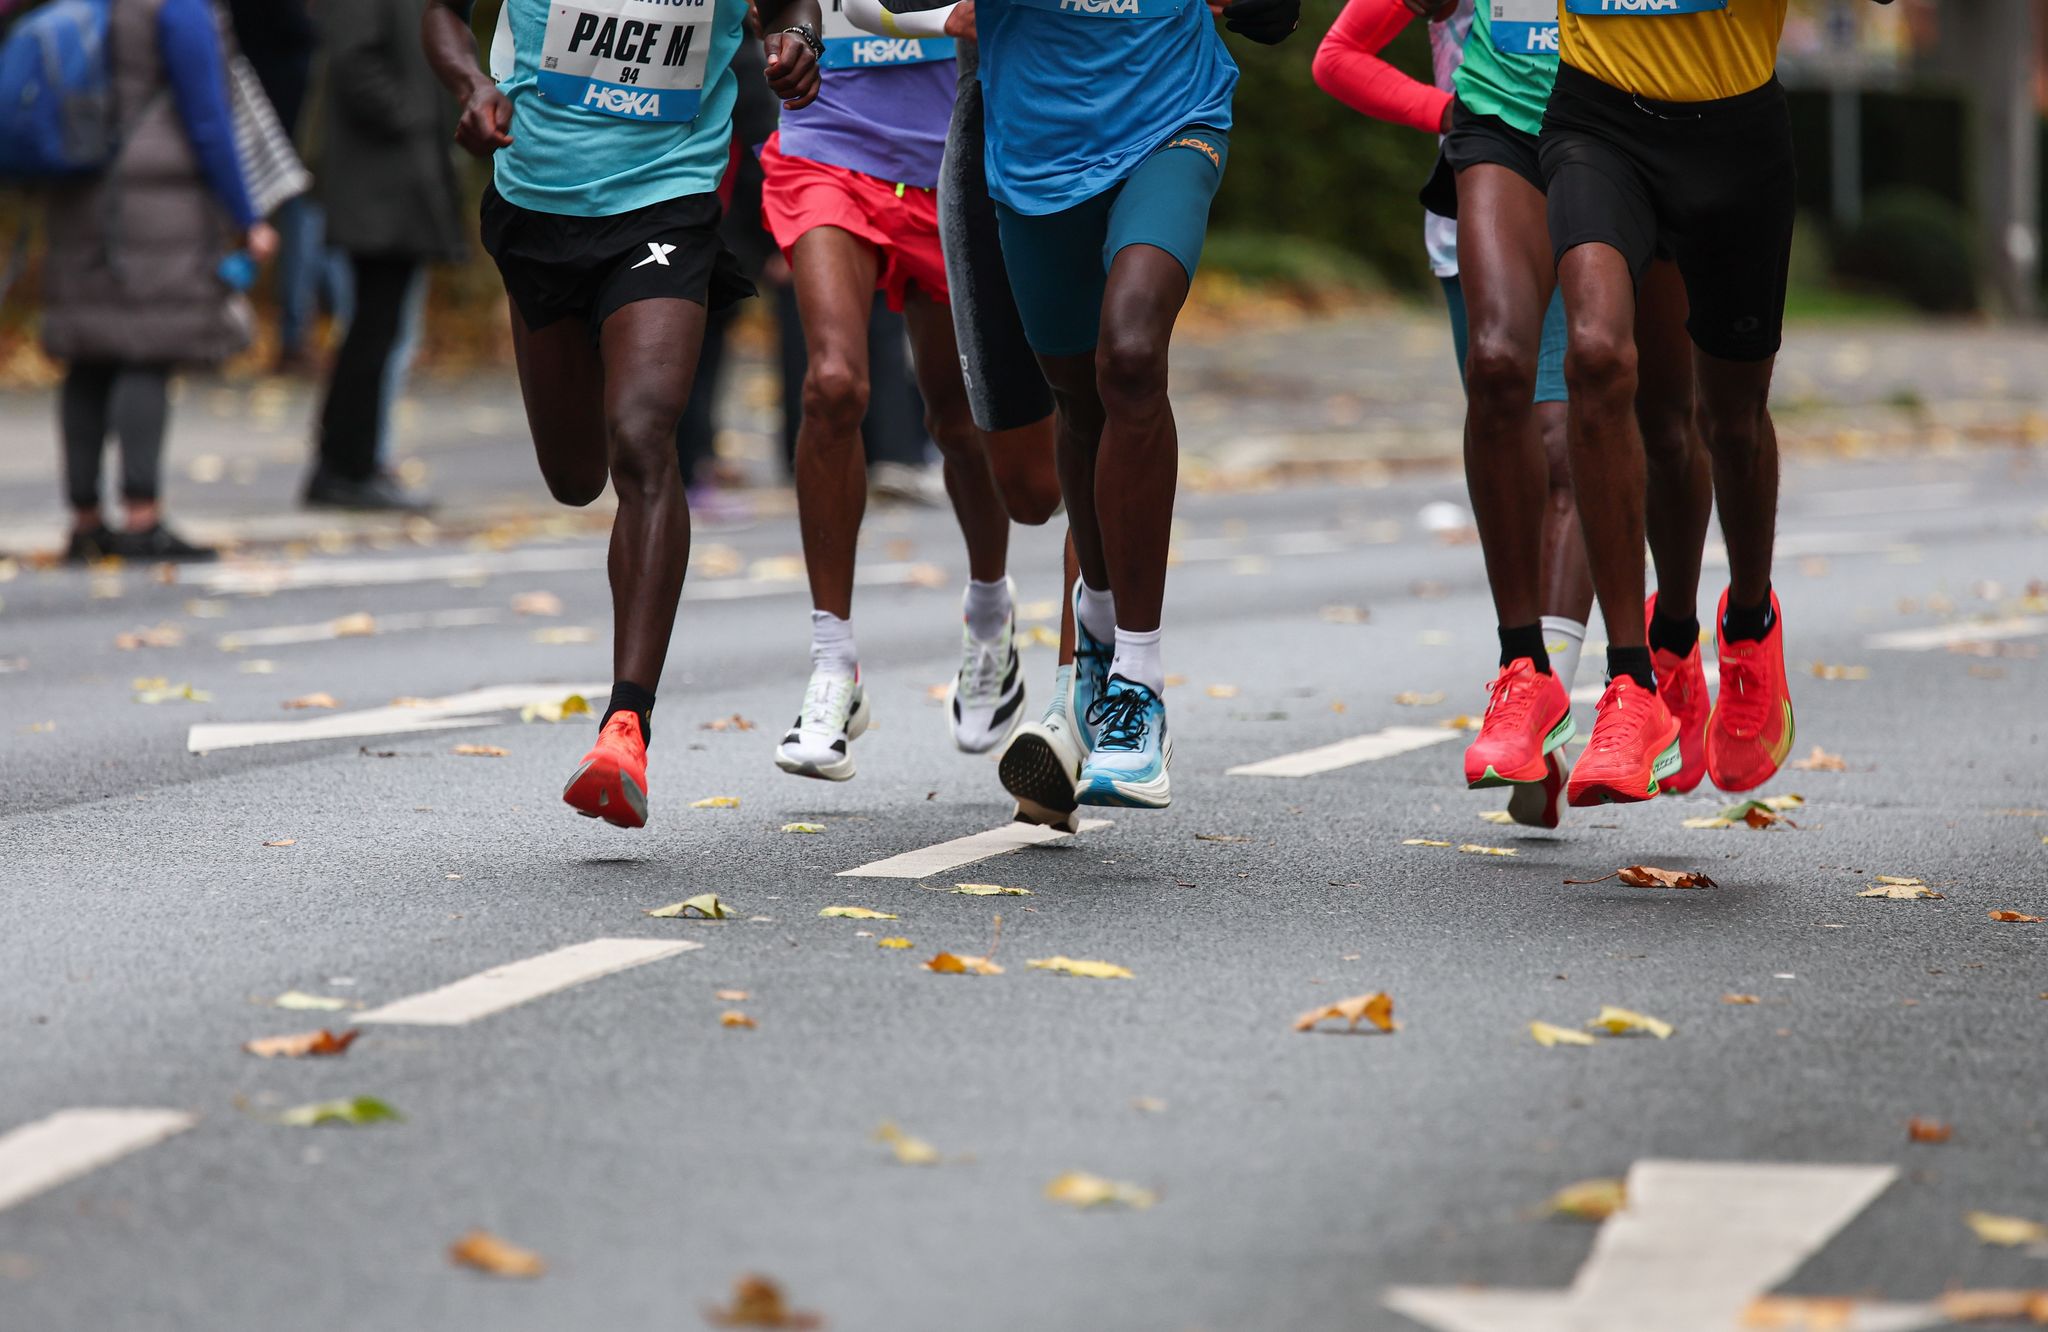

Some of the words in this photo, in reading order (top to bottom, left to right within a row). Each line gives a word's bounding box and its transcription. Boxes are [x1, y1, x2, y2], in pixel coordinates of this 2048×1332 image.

[568, 12, 662, 64] PACE
[662, 25, 695, 67] M
[852, 39, 923, 64] HOKA
[619, 66, 640, 84] 94
[583, 84, 660, 117] HOKA
[1168, 139, 1219, 167] HOKA
